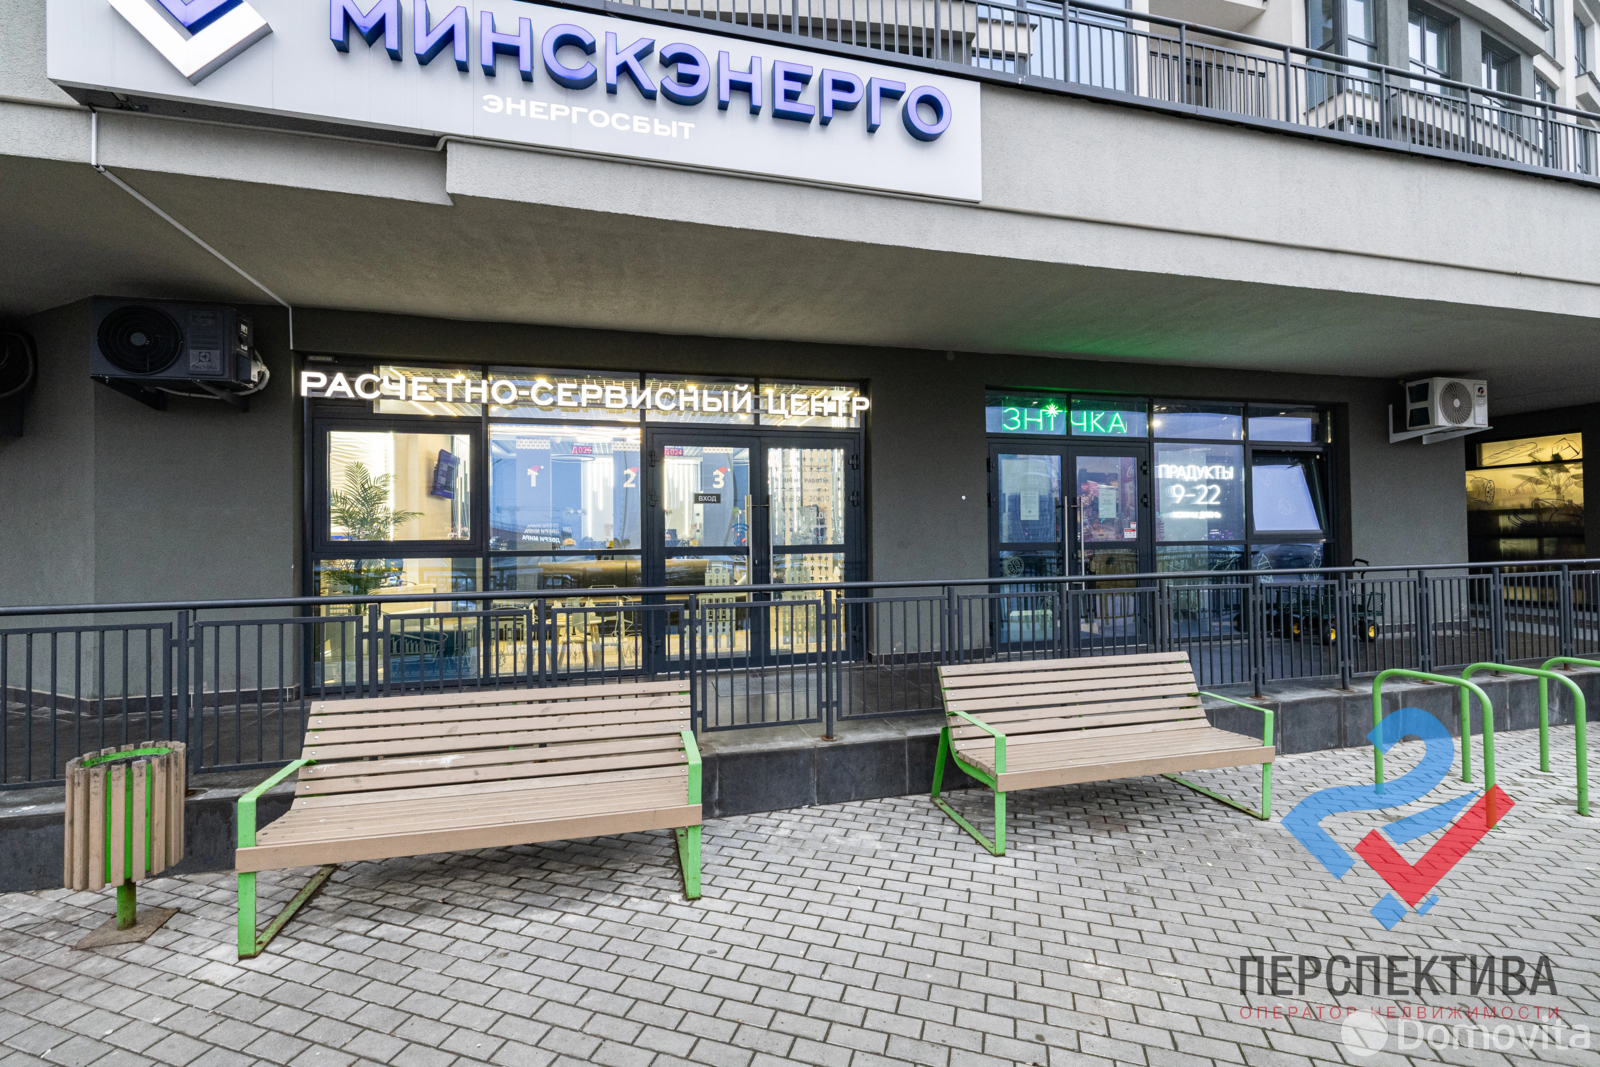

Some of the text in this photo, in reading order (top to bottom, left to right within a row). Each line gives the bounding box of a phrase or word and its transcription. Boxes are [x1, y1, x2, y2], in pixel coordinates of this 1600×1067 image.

[328, 0, 954, 144] МИНСКЭНЕРГО
[481, 93, 696, 142] ЭНЕРГОСБЫТ
[300, 370, 870, 418] РАСЧЕТНО-СЕРВИСНЫЙ ЦЕНТР
[623, 470, 637, 487] 2
[712, 470, 725, 489] 3
[698, 495, 717, 503] ВХОД
